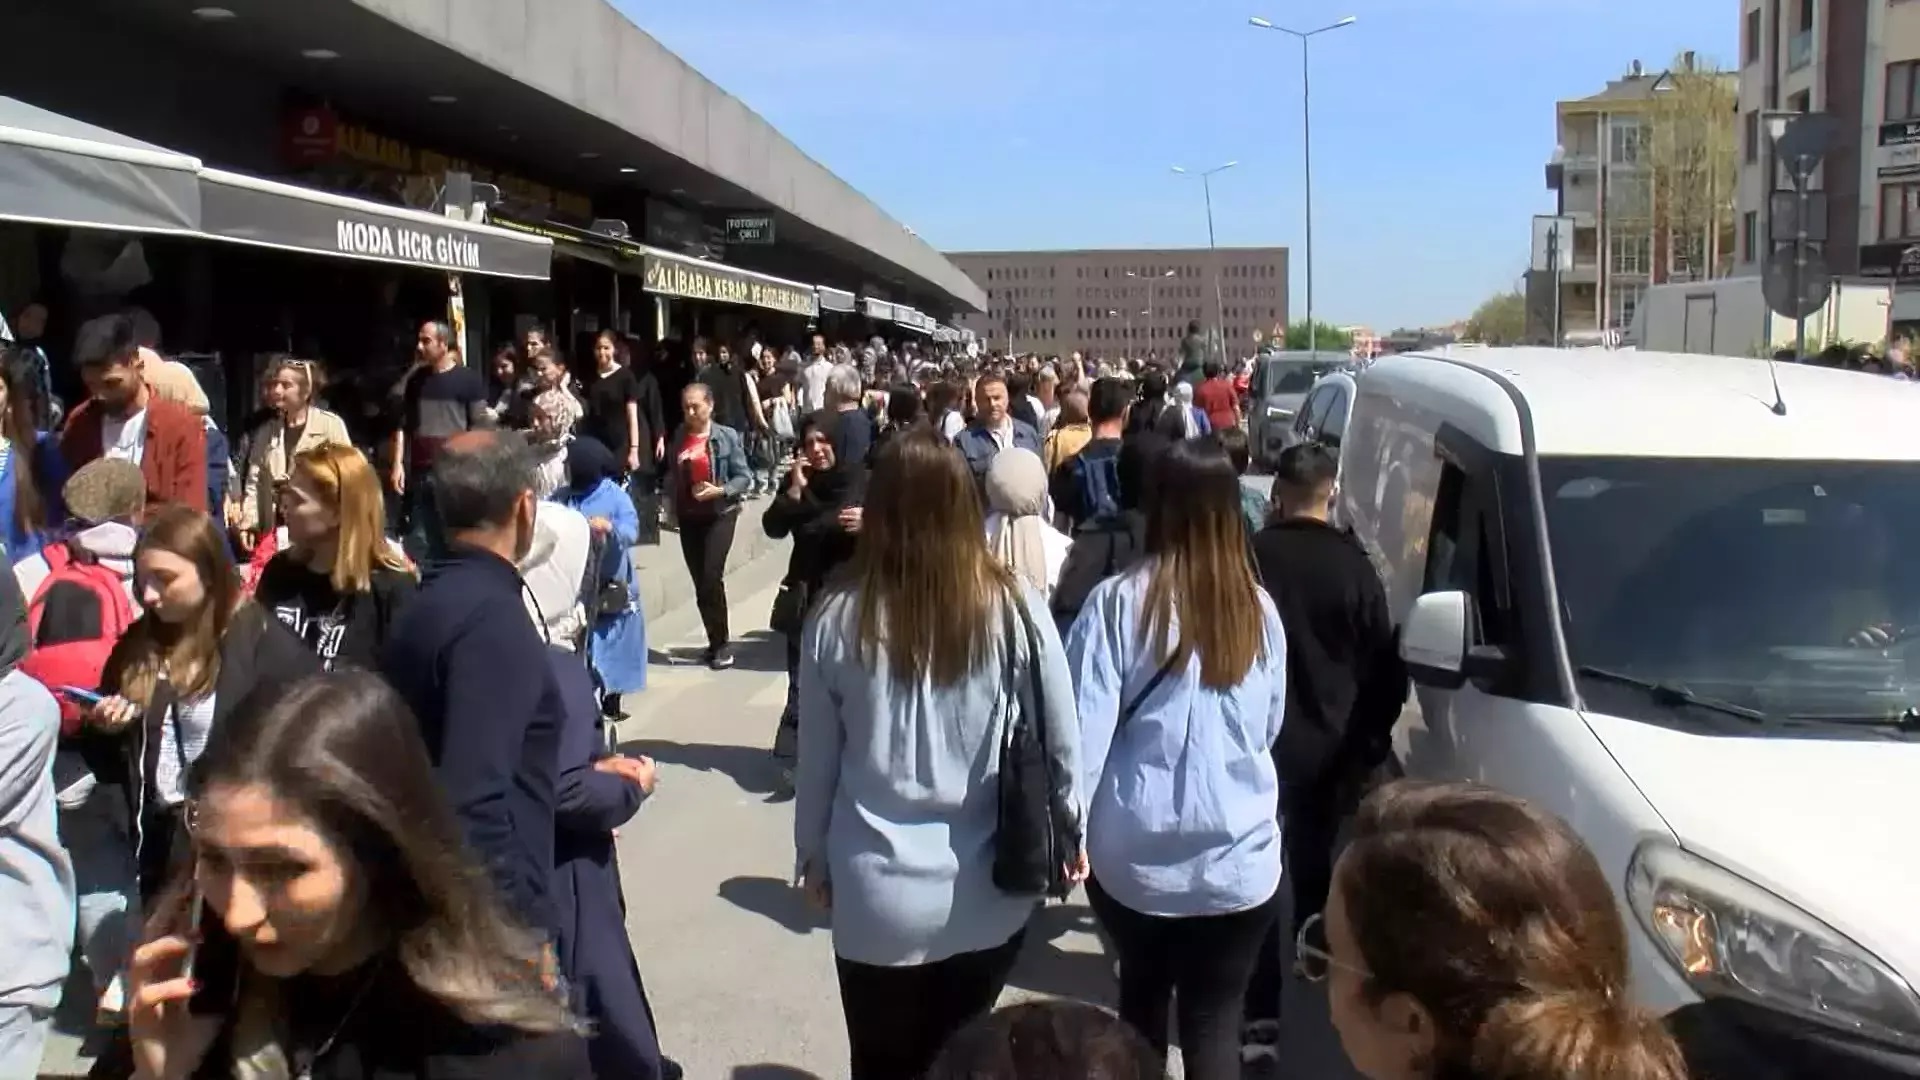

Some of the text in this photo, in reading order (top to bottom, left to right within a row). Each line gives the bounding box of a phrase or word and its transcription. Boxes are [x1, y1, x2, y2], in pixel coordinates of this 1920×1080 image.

[337, 219, 480, 268] MODA HCR GİYİM
[657, 264, 712, 296] ALİBABA
[713, 279, 748, 300] KEBAP
